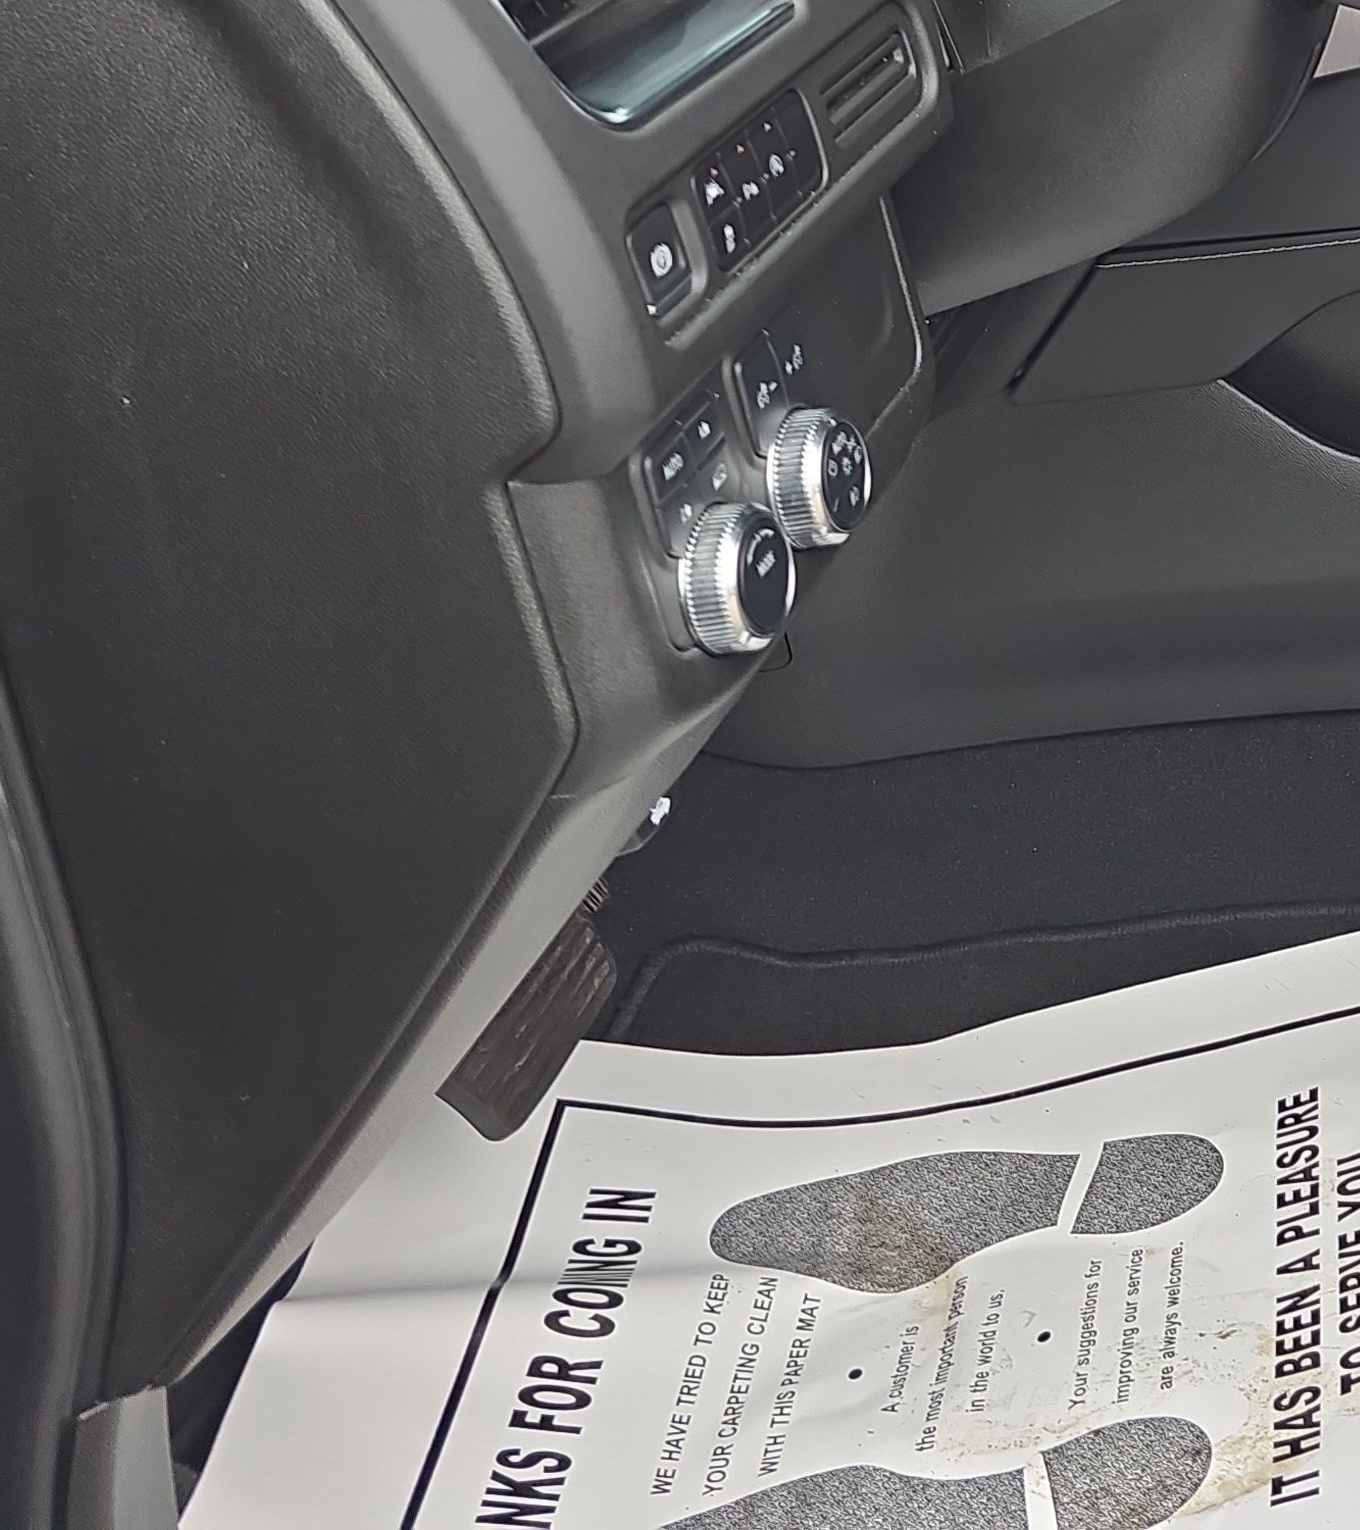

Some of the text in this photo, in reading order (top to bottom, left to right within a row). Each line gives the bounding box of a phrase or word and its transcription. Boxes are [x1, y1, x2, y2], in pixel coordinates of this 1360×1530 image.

[508, 1355, 604, 1435] FOR
[581, 1188, 657, 1223] IN
[881, 1325, 919, 1413] A customer is
[915, 1275, 969, 1452] the most important person
[977, 1329, 997, 1366] world
[981, 1313, 1000, 1326] to
[1067, 1259, 1102, 1410] Your suggestions for
[1111, 1248, 1144, 1404] improving our service
[1158, 1241, 1184, 1390] are always welcome.
[1270, 1086, 1321, 1507] IT HAS BEEN A PLEASURE
[650, 1273, 730, 1496] WE HAVE TRIED TO KEEP
[702, 1275, 779, 1496] YOUR CARPETING CLEAN
[758, 1293, 821, 1478] WITH THIS PAPER MAT
[965, 1398, 985, 1413] in
[969, 1370, 989, 1394] the
